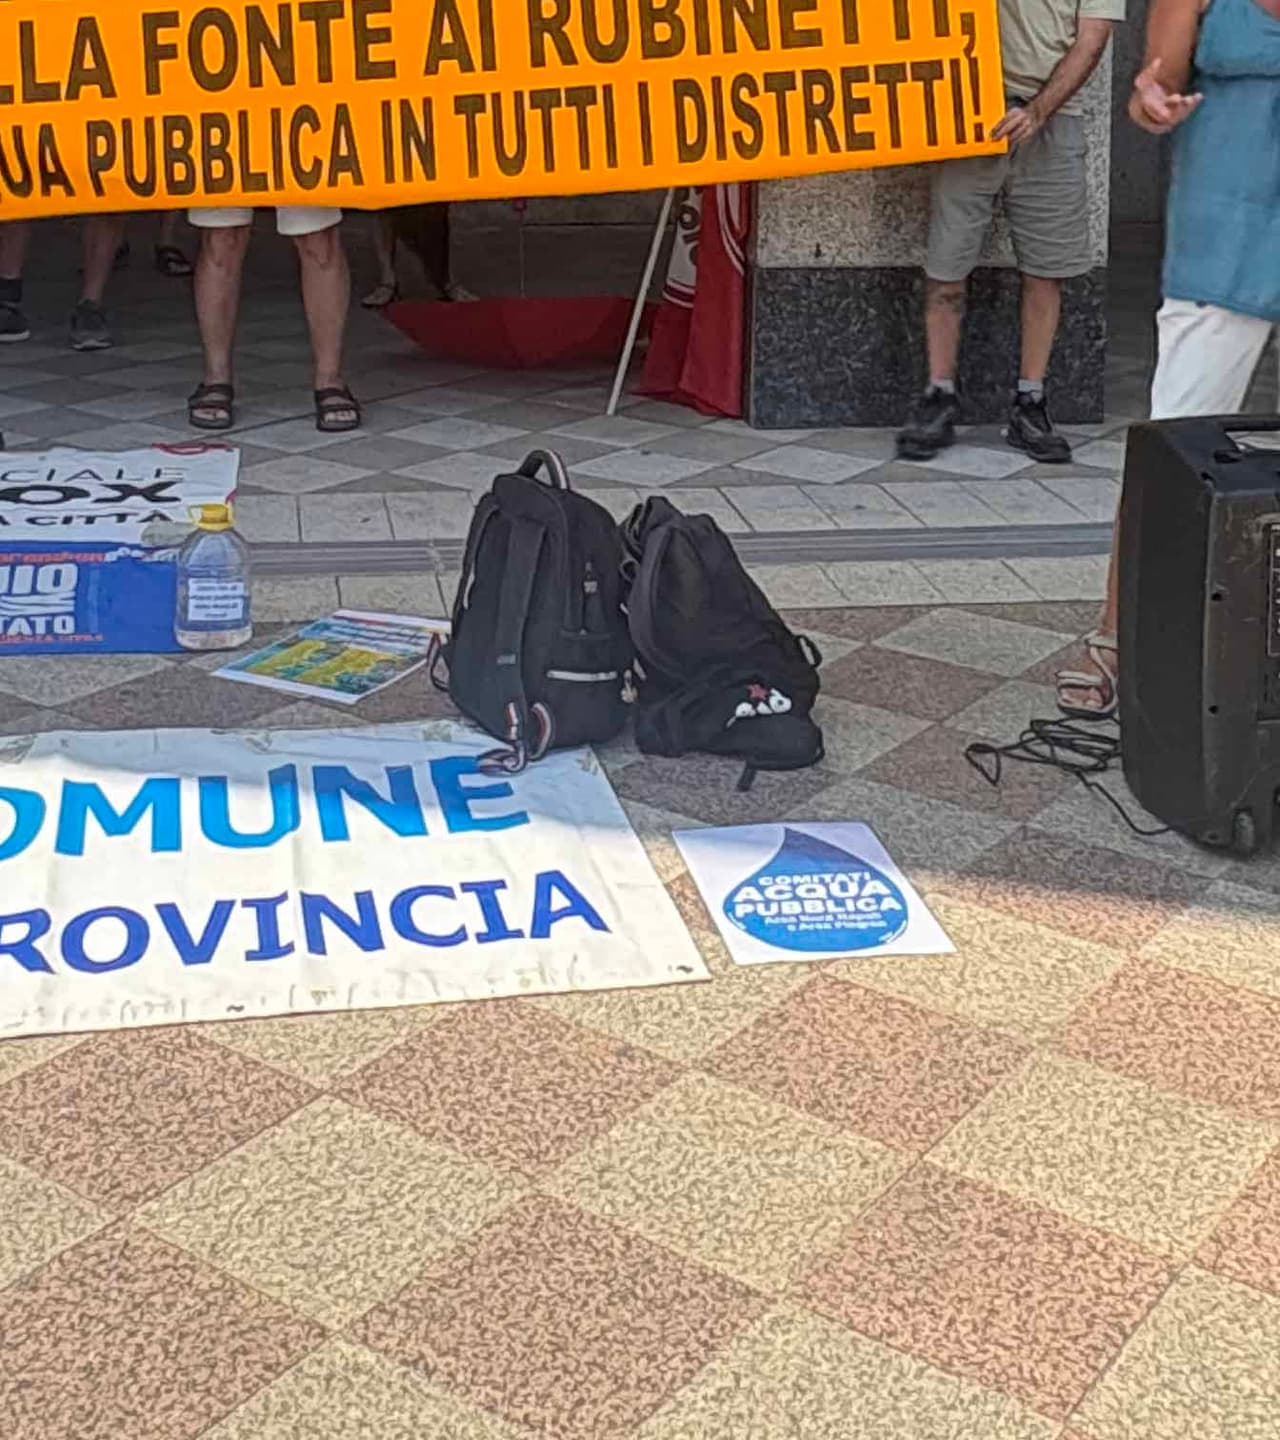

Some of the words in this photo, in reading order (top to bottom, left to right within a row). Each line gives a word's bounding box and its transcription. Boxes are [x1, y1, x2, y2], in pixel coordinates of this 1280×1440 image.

[86, 103, 365, 198] PUBBLICA
[381, 96, 436, 184] IN
[453, 83, 619, 179] TUTTI
[637, 81, 654, 166] I
[672, 56, 985, 163] DISTRETTI!
[758, 871, 871, 886] COMITATI
[733, 880, 892, 903] ACQUA
[735, 897, 903, 918] PUBBLICA
